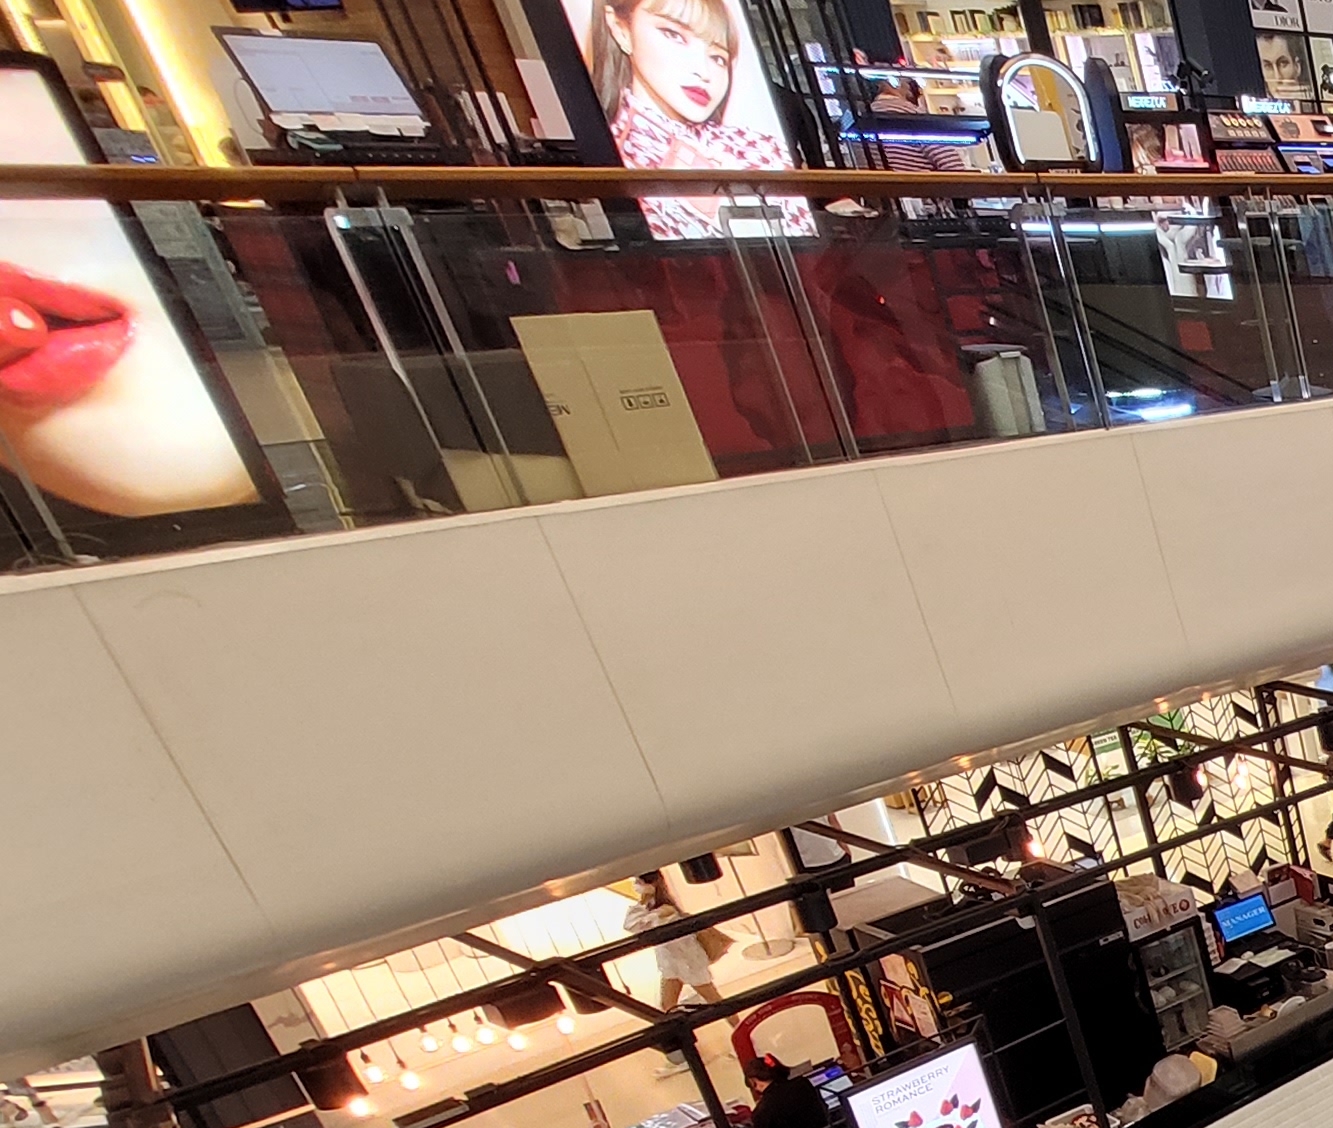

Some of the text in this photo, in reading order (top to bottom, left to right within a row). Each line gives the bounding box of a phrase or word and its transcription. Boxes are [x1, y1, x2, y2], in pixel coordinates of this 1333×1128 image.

[1222, 906, 1267, 929] MANAGER
[871, 1065, 950, 1106] STRAWBERRY
[875, 1082, 933, 1115] ROMANCE
